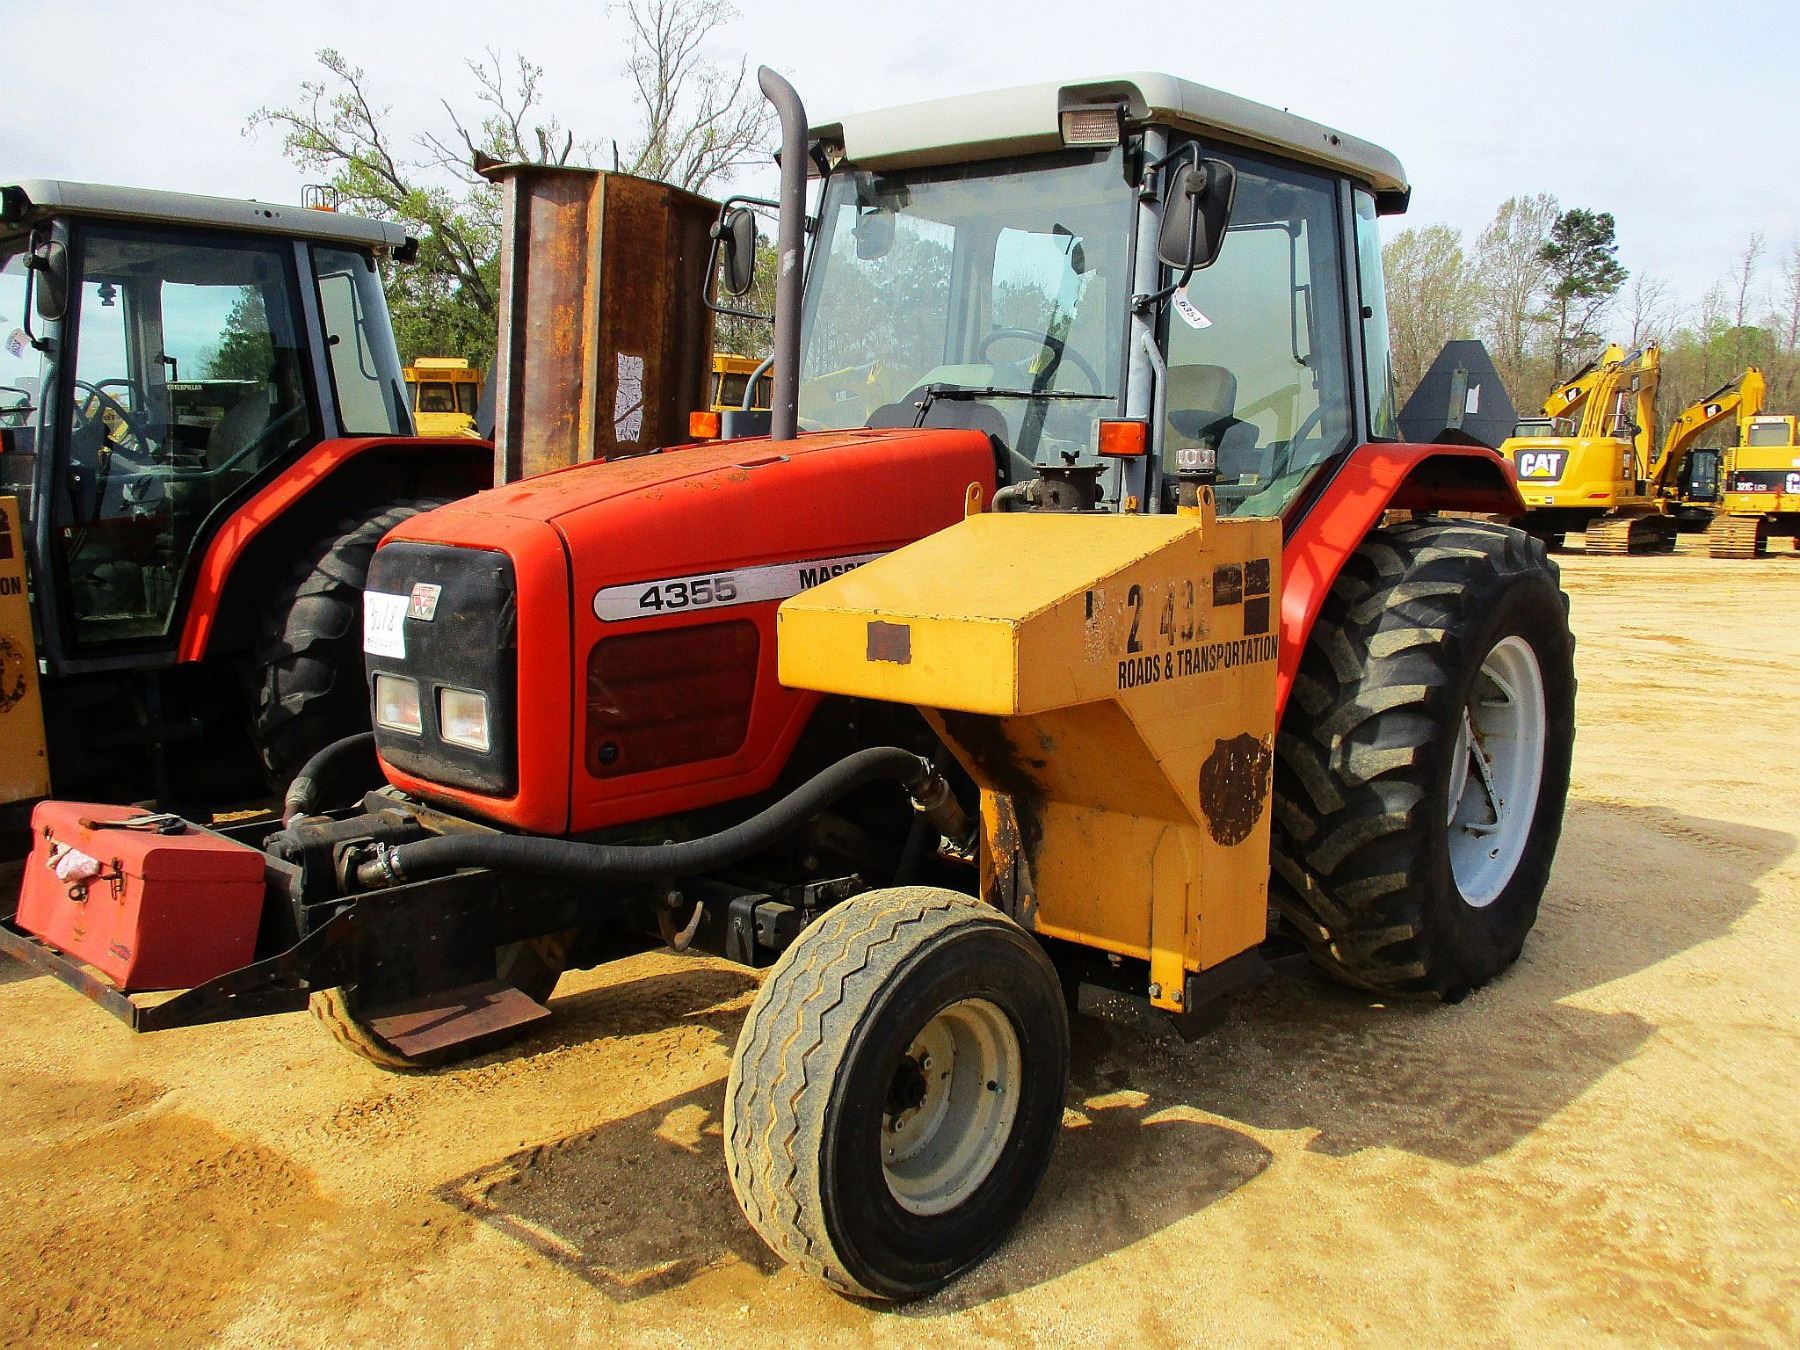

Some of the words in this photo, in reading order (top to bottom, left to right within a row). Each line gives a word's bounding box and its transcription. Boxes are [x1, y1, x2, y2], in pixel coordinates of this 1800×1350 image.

[1520, 452, 1562, 477] CAT
[639, 576, 737, 611] 4355
[1118, 654, 1160, 690] ROADS
[1164, 651, 1174, 680] &
[1176, 634, 1279, 677] TRANSPORTATION
